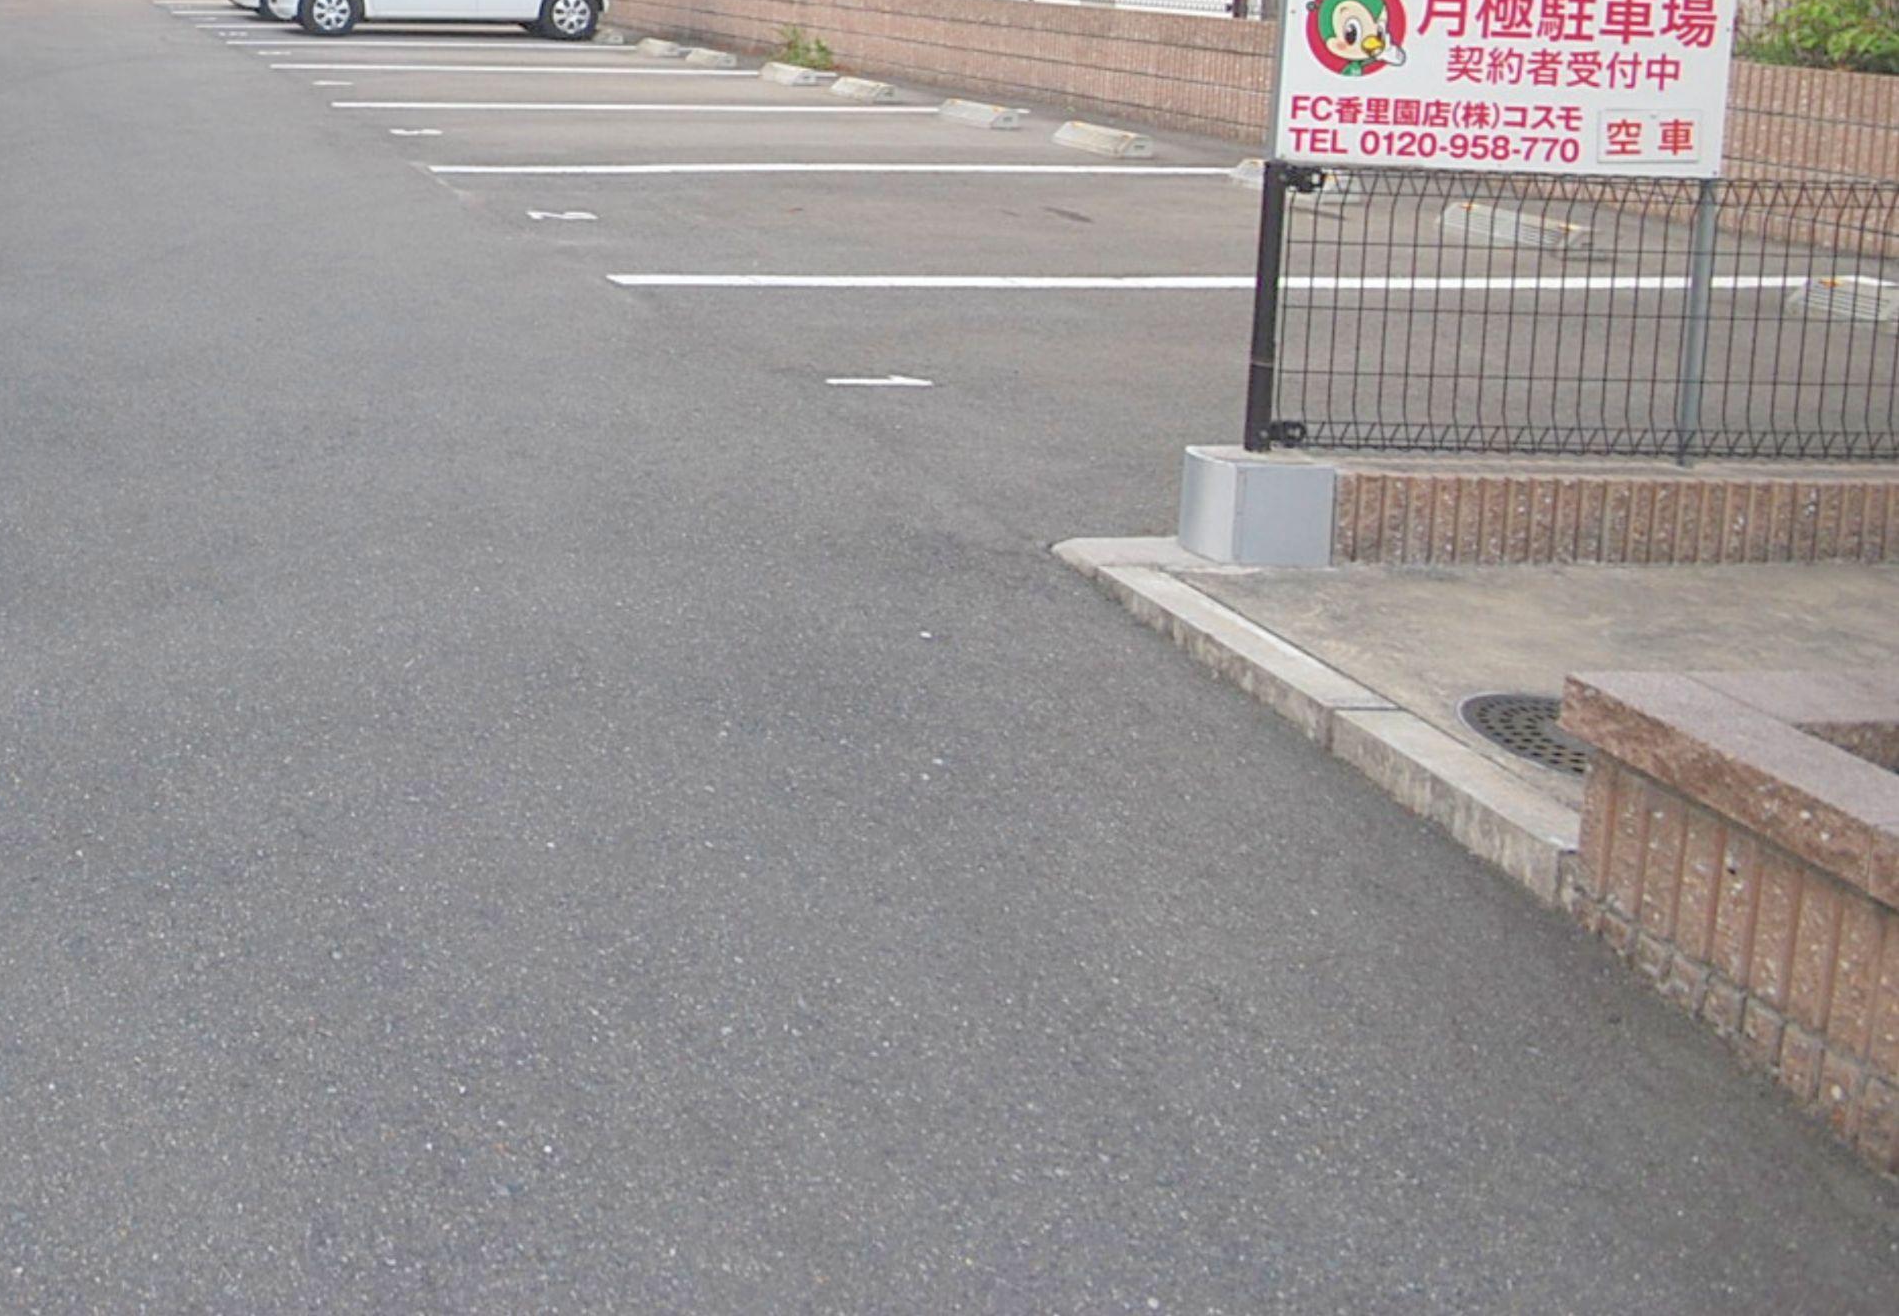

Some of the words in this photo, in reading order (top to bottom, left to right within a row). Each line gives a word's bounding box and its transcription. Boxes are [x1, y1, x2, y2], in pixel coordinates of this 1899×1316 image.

[1446, 45, 1682, 92] 契約者受付中
[1289, 127, 1349, 155] TEL
[1359, 130, 1581, 164] 0120-958-770
